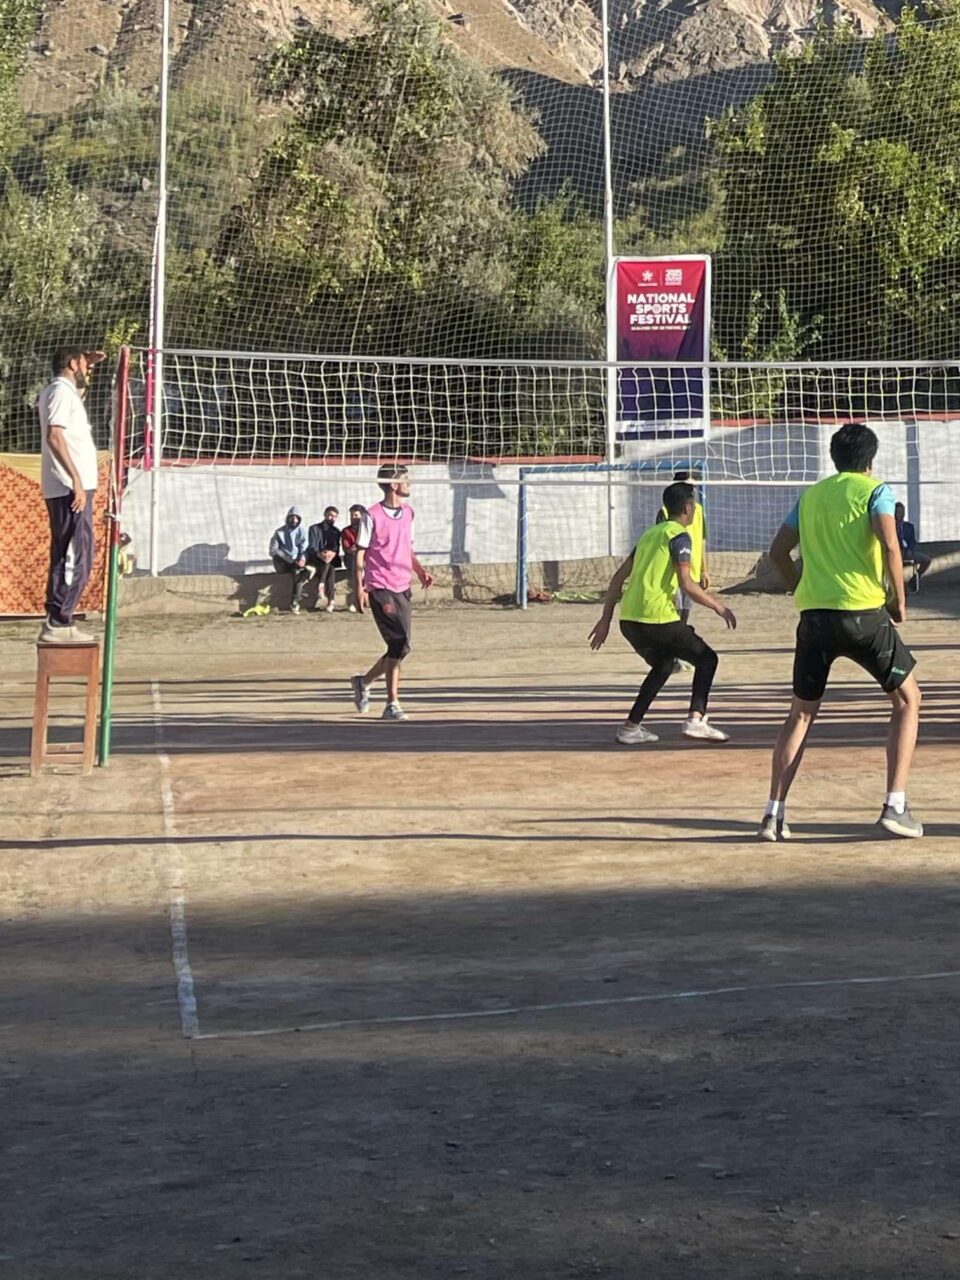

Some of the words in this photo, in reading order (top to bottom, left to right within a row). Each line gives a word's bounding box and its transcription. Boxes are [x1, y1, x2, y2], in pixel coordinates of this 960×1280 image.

[627, 293, 695, 304] NATIONAL
[635, 303, 687, 314] SPORTS
[629, 314, 691, 325] FESTIVAL
